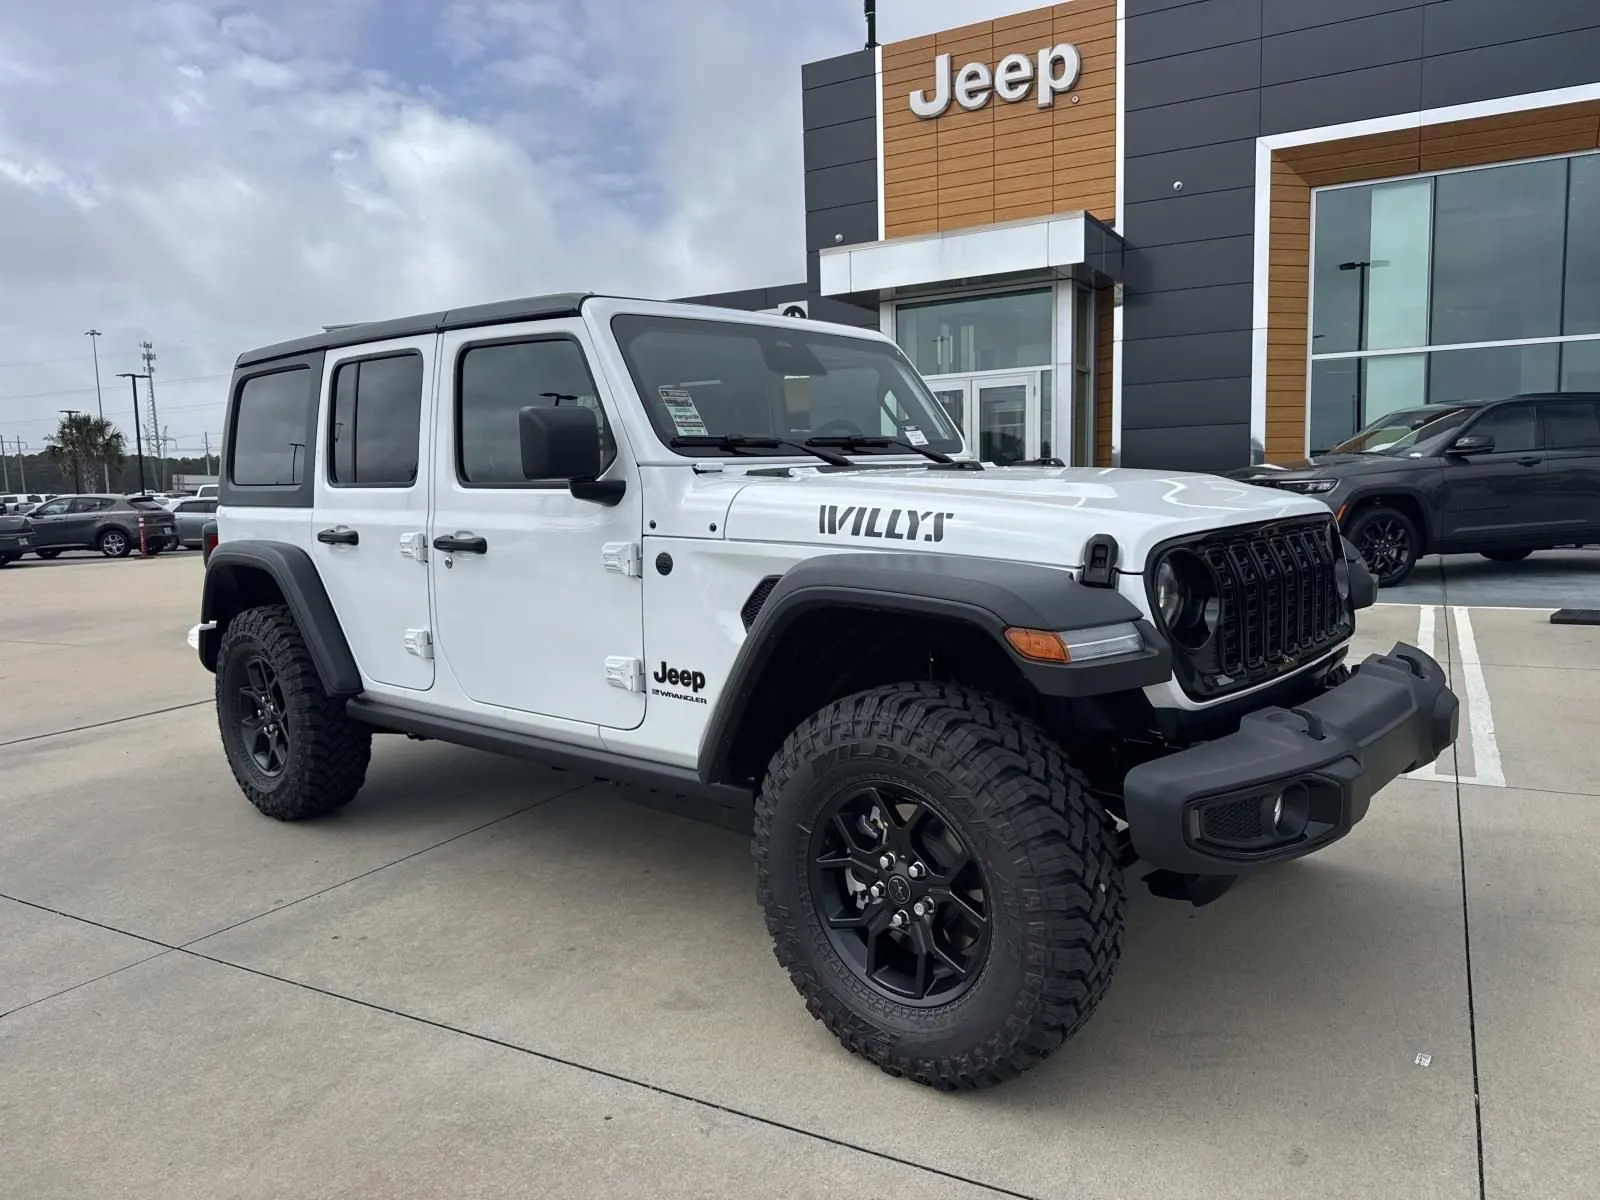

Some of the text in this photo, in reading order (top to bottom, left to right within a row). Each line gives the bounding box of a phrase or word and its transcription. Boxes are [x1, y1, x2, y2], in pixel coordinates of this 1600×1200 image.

[908, 43, 1081, 120] Jeep
[819, 505, 954, 542] WILLYS
[653, 661, 706, 693] Jeep
[659, 690, 708, 704] WRANGLER
